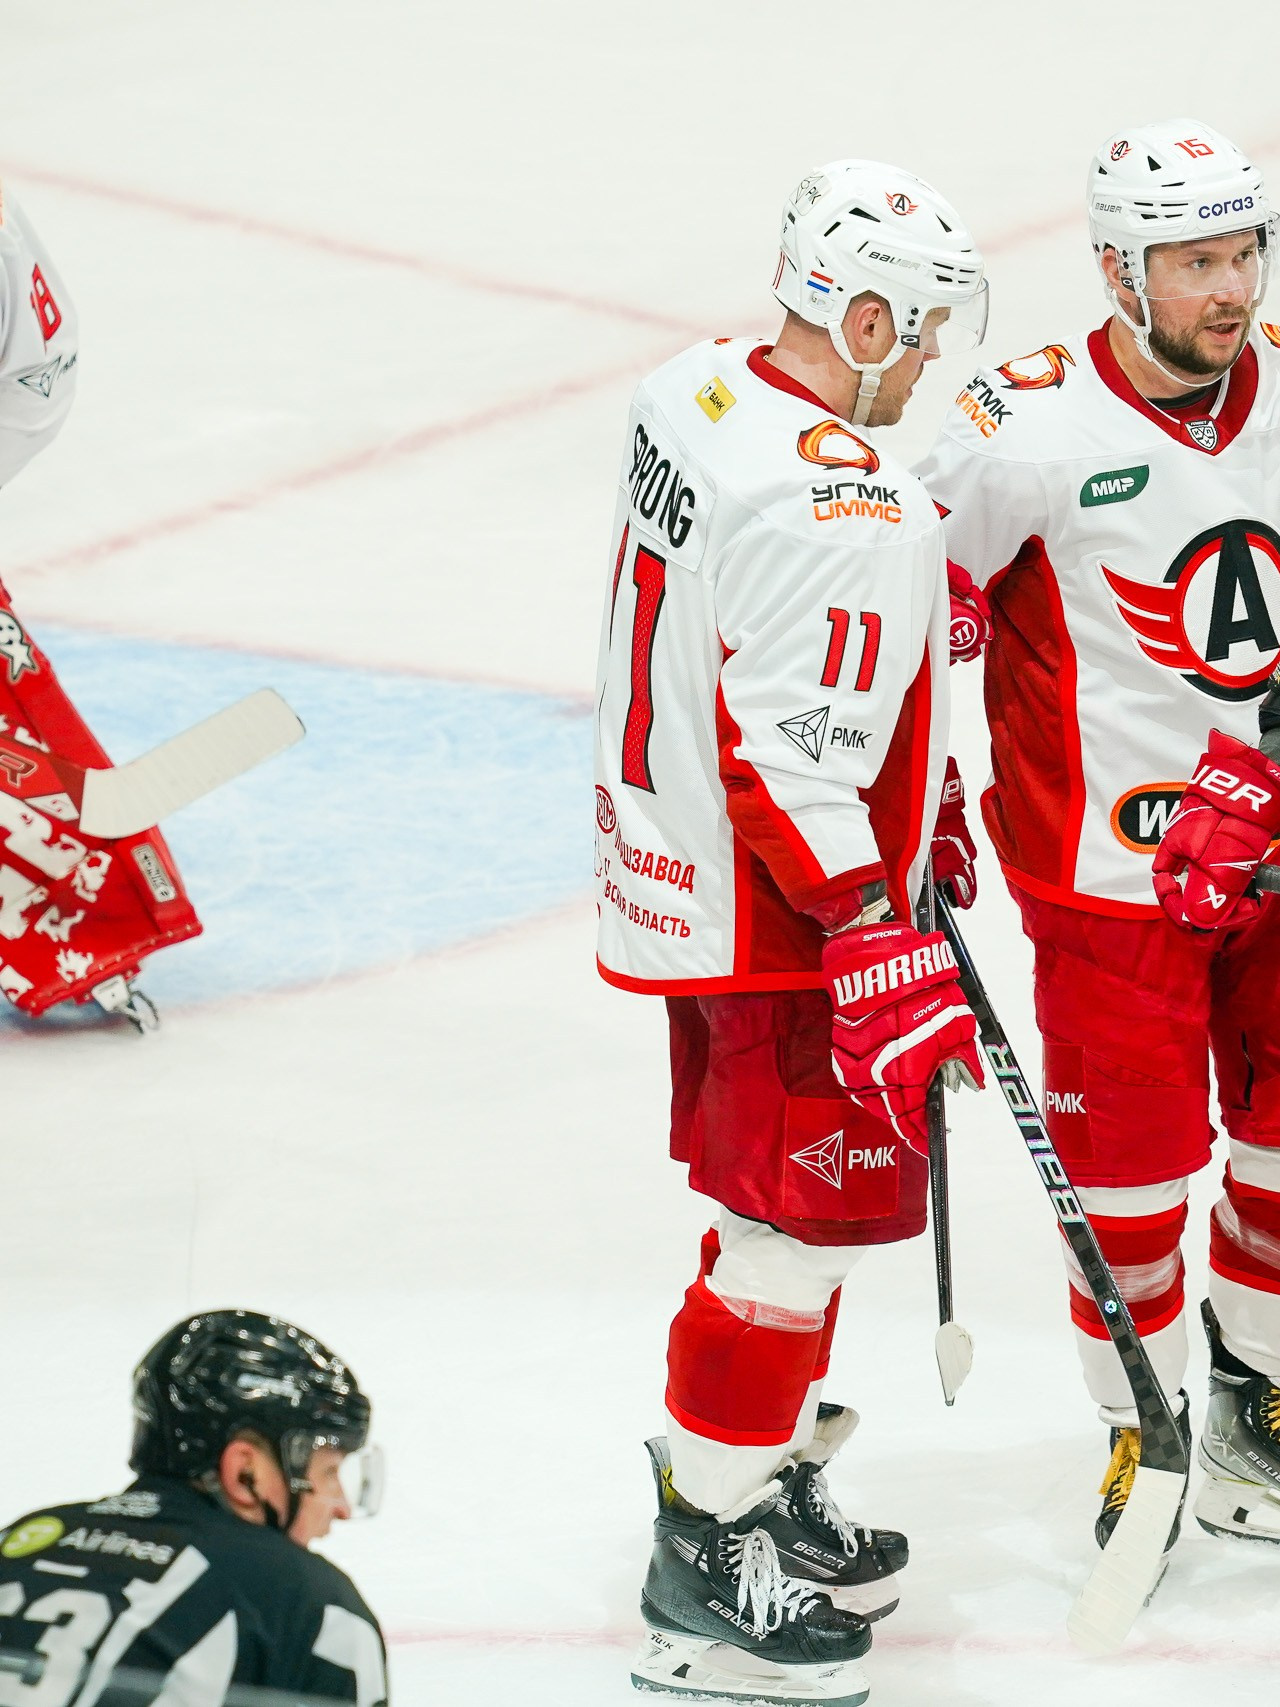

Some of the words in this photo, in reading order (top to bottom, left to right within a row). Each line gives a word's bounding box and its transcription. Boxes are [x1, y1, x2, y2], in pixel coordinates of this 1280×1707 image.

[1174, 138, 1215, 159] 15
[812, 482, 901, 506] УГМК
[1091, 476, 1135, 498] МИР
[813, 501, 902, 523] UMMC
[820, 606, 882, 692] 11
[628, 902, 691, 939] ОБЛАСТЬ
[862, 929, 902, 942] SPRONG
[833, 940, 959, 1007] WARRIO
[913, 998, 942, 1021] COVERT
[984, 1042, 1086, 1224] BAUER
